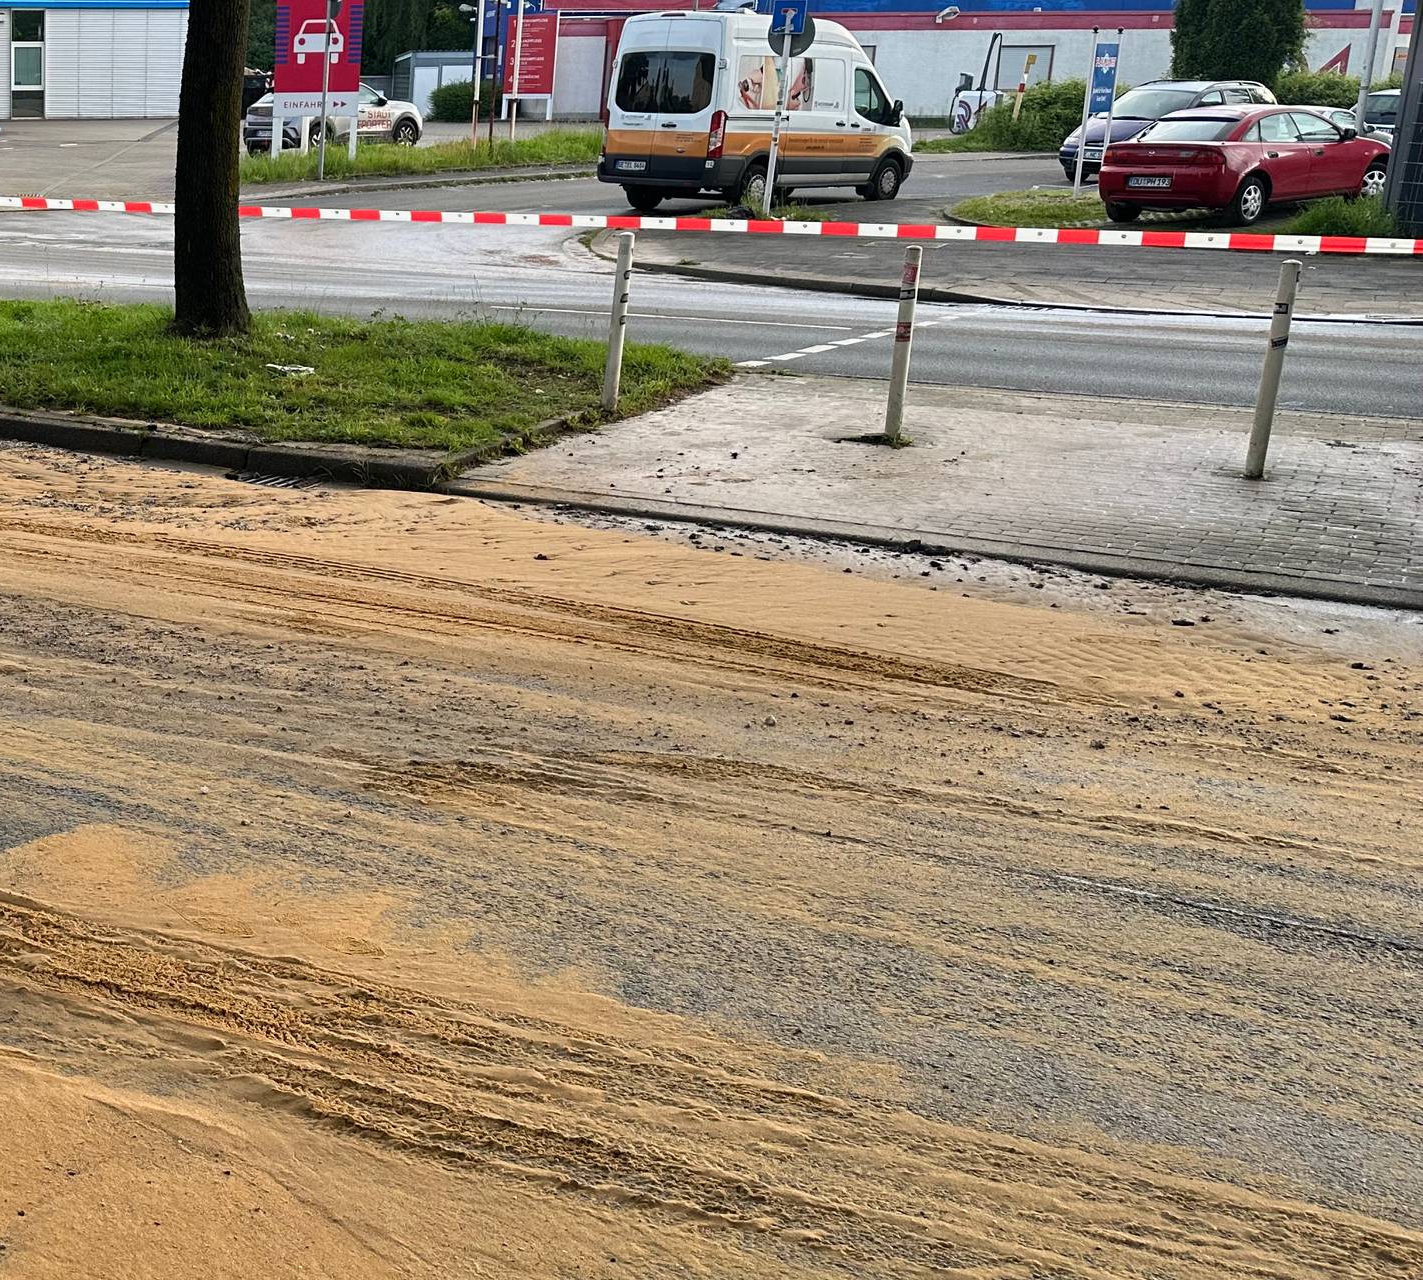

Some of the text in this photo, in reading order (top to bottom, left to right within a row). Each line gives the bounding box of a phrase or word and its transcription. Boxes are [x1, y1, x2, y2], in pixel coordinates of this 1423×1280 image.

[283, 100, 324, 109] EINFAHR
[367, 110, 391, 119] STADT
[357, 119, 392, 129] EPORTER
